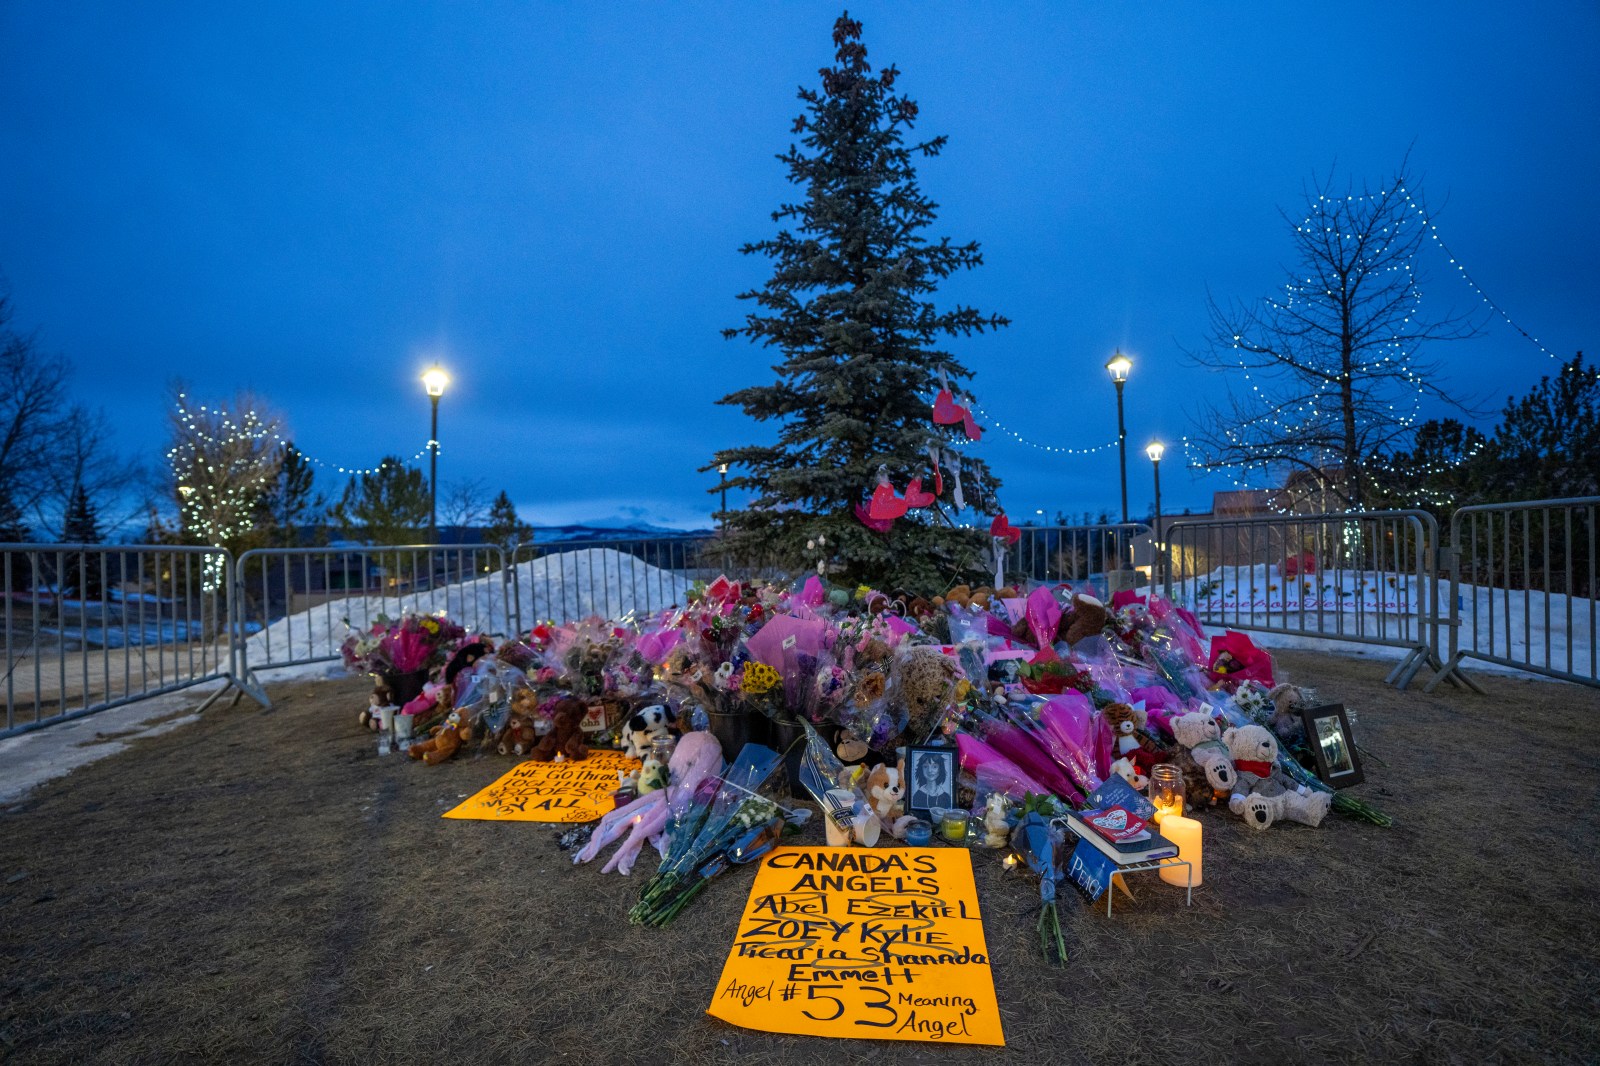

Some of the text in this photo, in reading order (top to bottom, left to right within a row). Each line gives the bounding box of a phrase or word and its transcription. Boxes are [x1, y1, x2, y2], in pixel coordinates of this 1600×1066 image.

[513, 769, 620, 781] WE GO Throu
[518, 787, 589, 797] DOES
[533, 798, 581, 811] ALL
[767, 852, 938, 874] CANADA'S
[790, 873, 940, 895] ANGEL'S
[1069, 855, 1103, 901] PEACE
[753, 895, 829, 914] Abel
[741, 918, 855, 942] ZOEY
[733, 941, 851, 961] Ticaria
[787, 963, 922, 985] Emmett
[720, 978, 774, 1007] Angel
[898, 993, 979, 1016] Meaning
[896, 1010, 973, 1040] Angel
